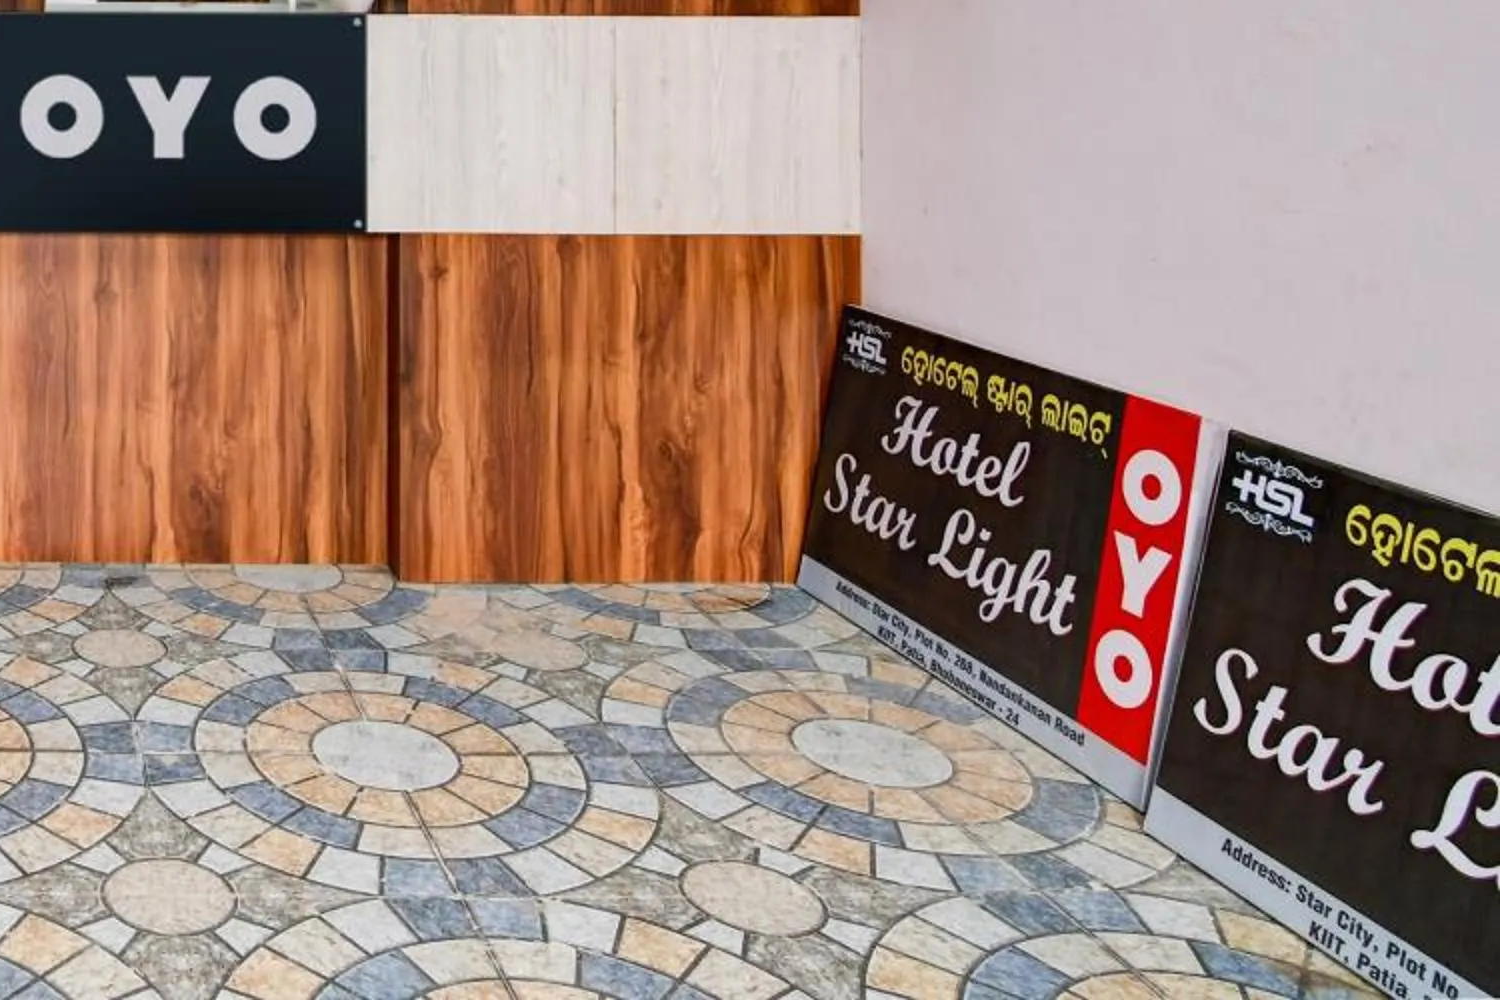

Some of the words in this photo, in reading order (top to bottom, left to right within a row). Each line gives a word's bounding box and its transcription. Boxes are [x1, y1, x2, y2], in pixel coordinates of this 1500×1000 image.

[20, 74, 317, 161] OYO
[846, 332, 888, 366] HSL
[881, 395, 1031, 507] Hotel
[1232, 469, 1316, 527] HSL
[824, 453, 916, 551] Star
[928, 509, 1077, 636] Light
[1094, 449, 1183, 710] OYO
[914, 628, 934, 650] Plot
[1054, 716, 1086, 747] Road
[1005, 708, 1020, 726] 24
[1193, 648, 1384, 815] Star
[1410, 769, 1500, 892] L
[1221, 838, 1292, 892] Address:
[1295, 885, 1333, 919] Star
[1337, 909, 1379, 953] City,
[1385, 940, 1427, 981] Plot
[1308, 921, 1350, 963] KIIT,
